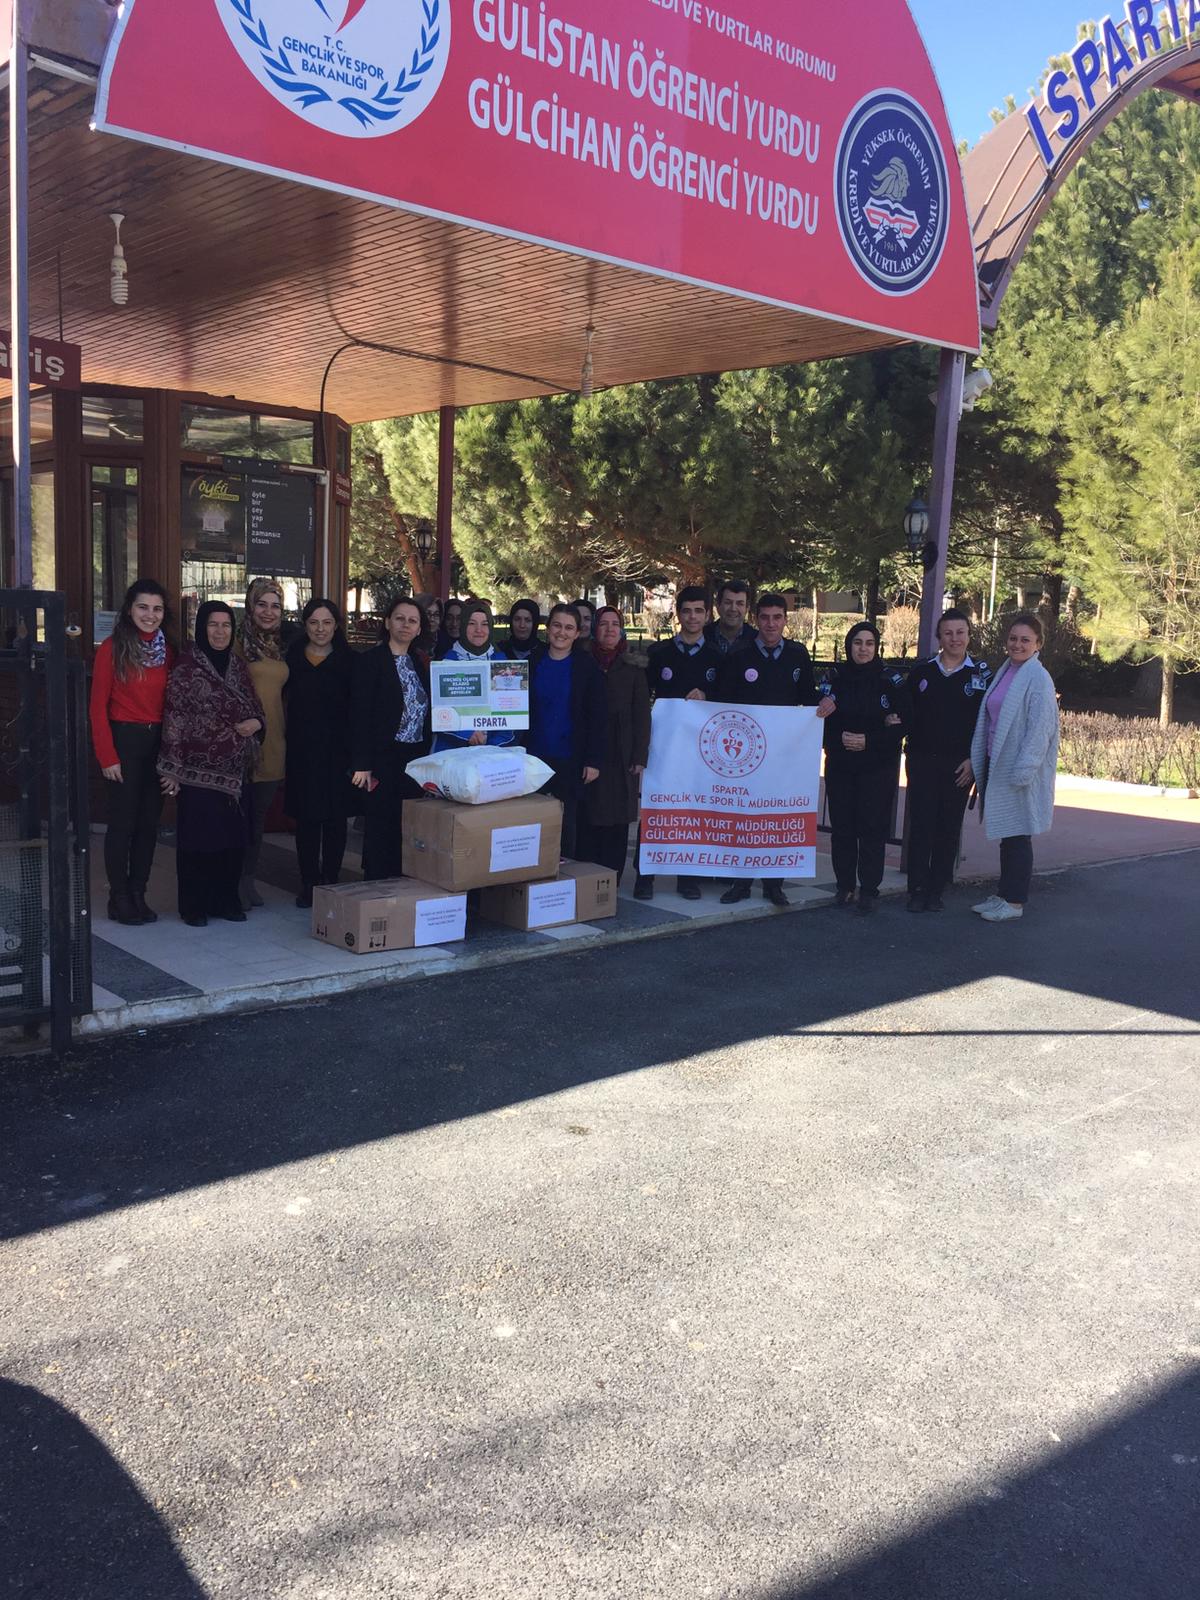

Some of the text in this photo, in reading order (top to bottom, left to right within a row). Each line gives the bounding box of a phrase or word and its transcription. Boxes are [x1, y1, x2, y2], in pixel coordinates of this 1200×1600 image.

[282, 36, 384, 80] GENÇLİK VE SPOR
[705, 6, 773, 56] YURTLAR
[775, 41, 836, 82] KURUMU
[302, 58, 367, 90] BAKANLIĞI
[627, 39, 738, 135] ÖĞRENCİ
[744, 95, 820, 163] YURDU
[468, 72, 819, 235] GÜLCİHAN ÖĞRENCİ YURDU
[861, 128, 931, 190] YÜKSEK ÖĞRENİM
[848, 168, 938, 273] KREDİ VE YURTLAR KURUMU
[473, 717, 508, 728] ISPARTA
[650, 792, 810, 809] GENÇLİK VE SPOR İL MÜDÜRLÜĞÜ
[712, 784, 750, 796] ISPARTA
[645, 828, 806, 845] GÜLCİHAN YURT MÜDÜRLÜĞÜ
[647, 815, 805, 832] GÜLİSTAN YURT MÜDÜRLÜĞÜ
[698, 853, 739, 866] ELLER
